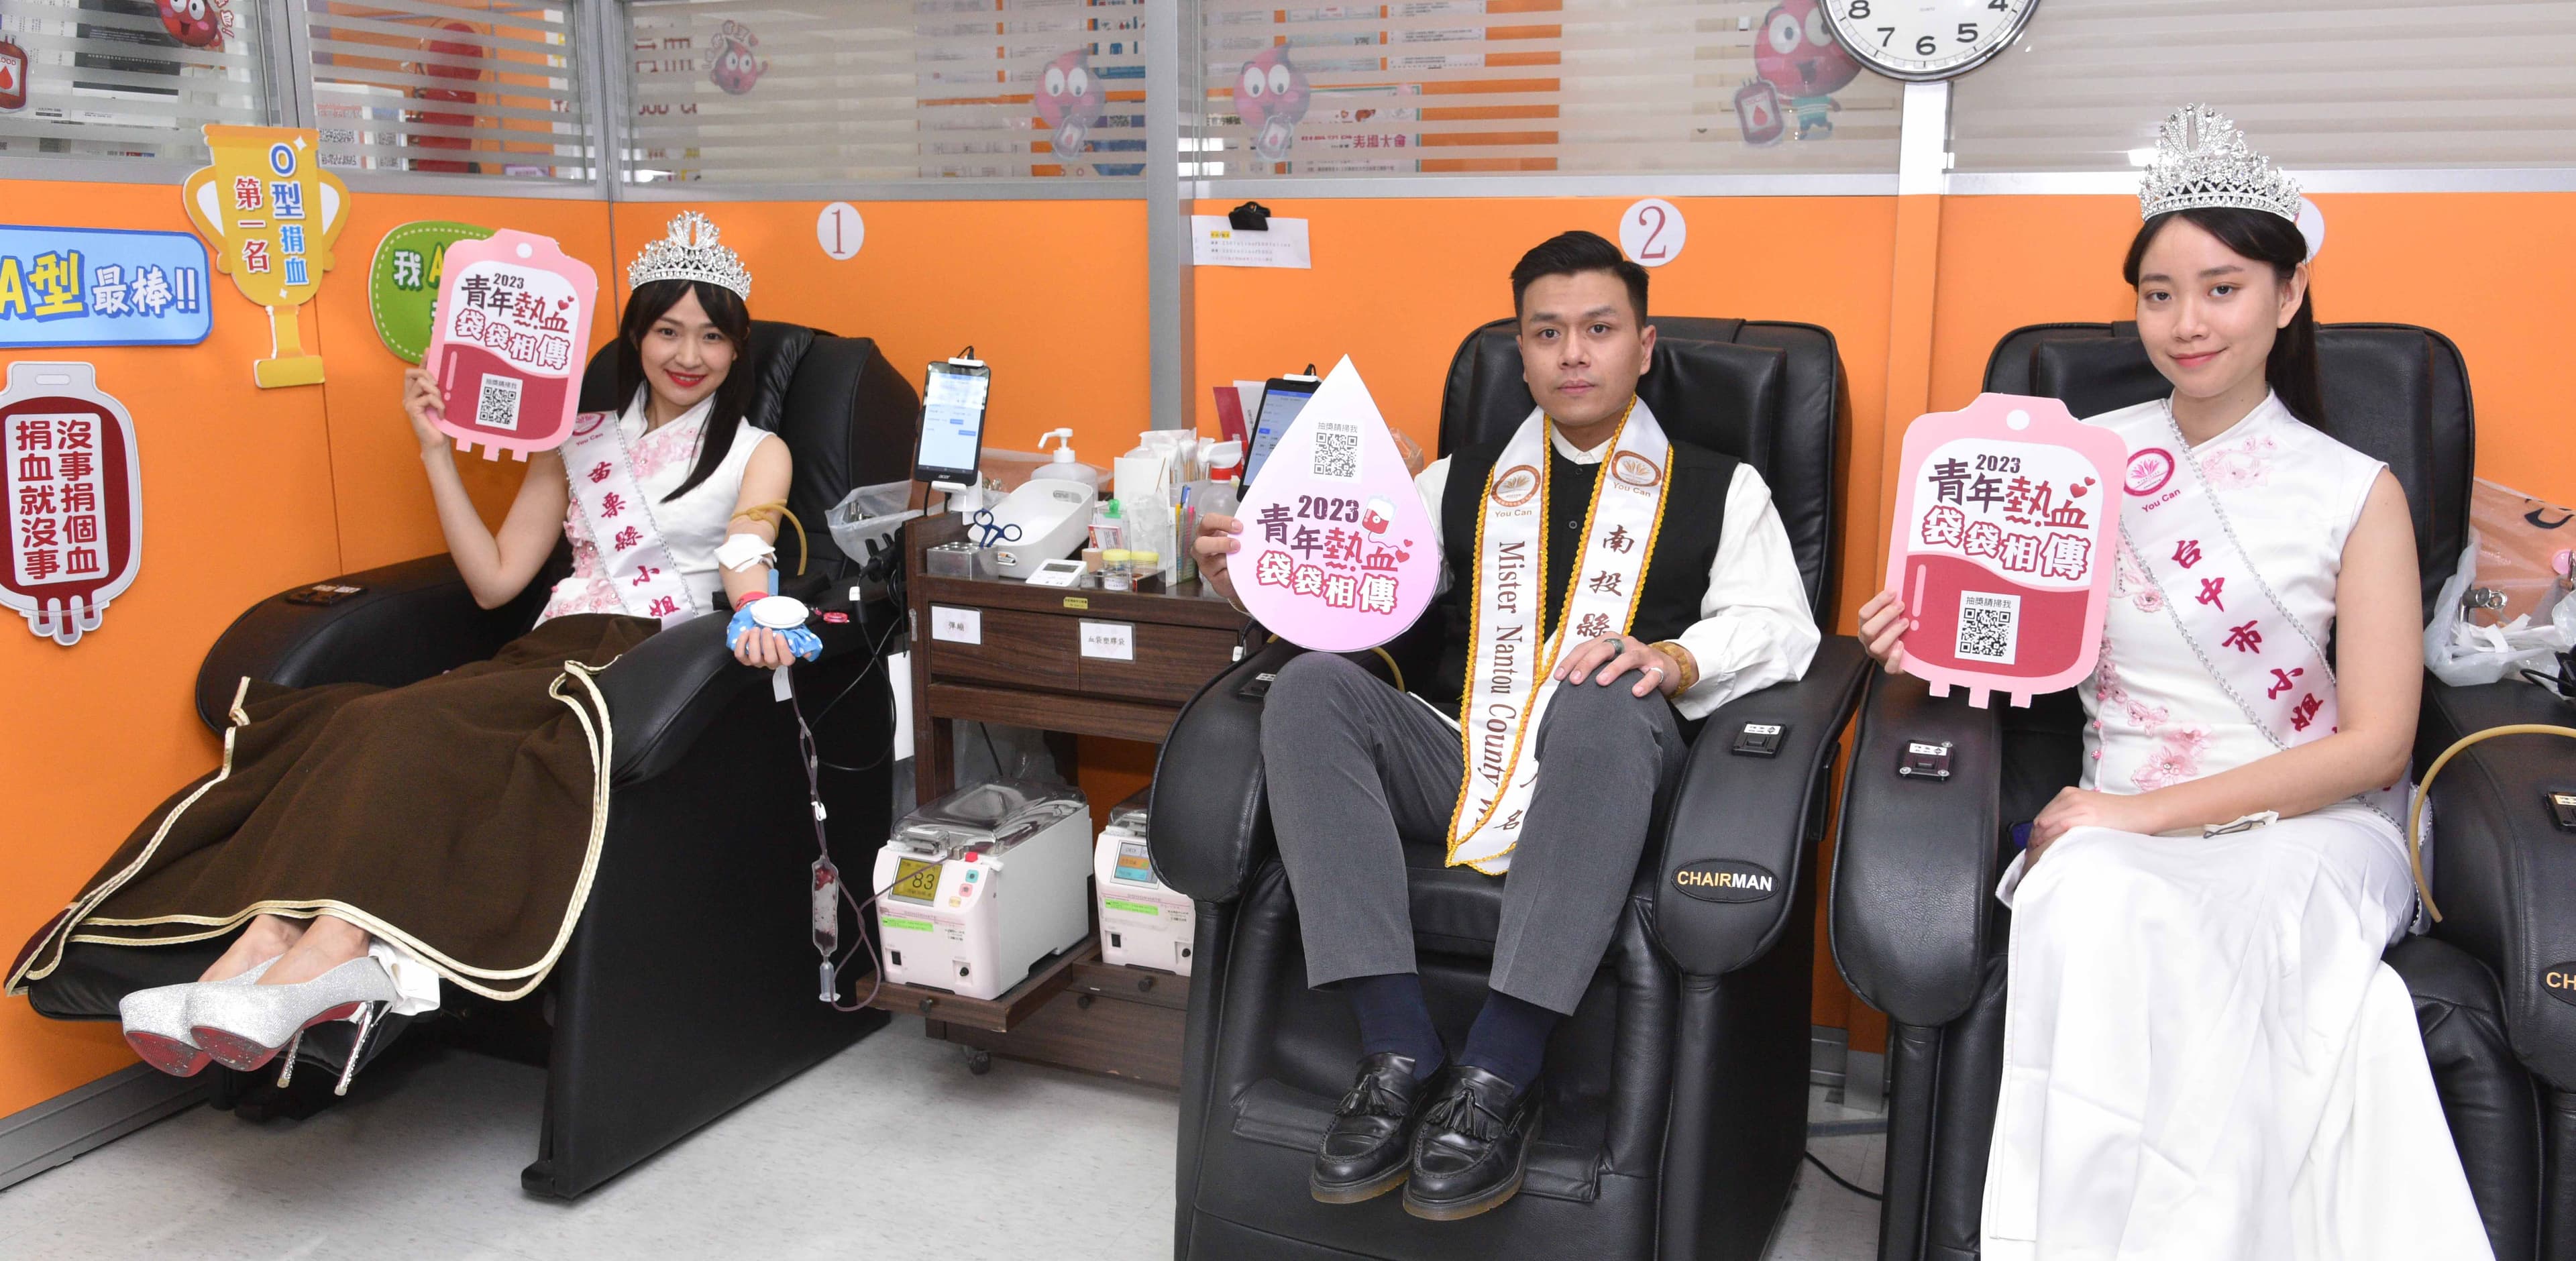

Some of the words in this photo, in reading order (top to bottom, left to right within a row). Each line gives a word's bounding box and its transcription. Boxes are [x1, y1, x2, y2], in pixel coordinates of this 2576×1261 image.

[1878, 27, 1895, 47] 7
[1916, 36, 1936, 56] 6
[1956, 23, 1978, 43] 5
[235, 176, 270, 272] 第一名
[270, 144, 308, 284] O型捐血
[831, 209, 846, 254] 1
[1638, 206, 1667, 260] 2
[462, 274, 570, 333] 青年熱血
[493, 274, 525, 289] 2023
[455, 309, 570, 370] 袋袋相傳
[1613, 482, 1630, 491] You
[1633, 488, 1651, 498] Can
[1929, 457, 2089, 530] 青年熱血
[1976, 453, 2021, 474] 2023
[15, 420, 60, 580] 捐血就沒事
[57, 419, 100, 575] 沒事捐個血
[1297, 495, 1359, 523] 2023
[2141, 500, 2161, 512] You
[2161, 489, 2181, 502] Can
[587, 461, 681, 618] 苗栗縣小姐
[1256, 503, 1399, 572] 青年熱血
[1922, 504, 2091, 580] 袋袋相傳
[1256, 549, 1399, 615] 袋袋相傳
[1497, 541, 1525, 614] Mister
[1490, 623, 1523, 696] Nantou
[2171, 539, 2324, 732] 台中市小姐
[1477, 704, 1517, 788] County
[912, 872, 934, 890] 83
[1677, 870, 1772, 891] CHAIRMAN
